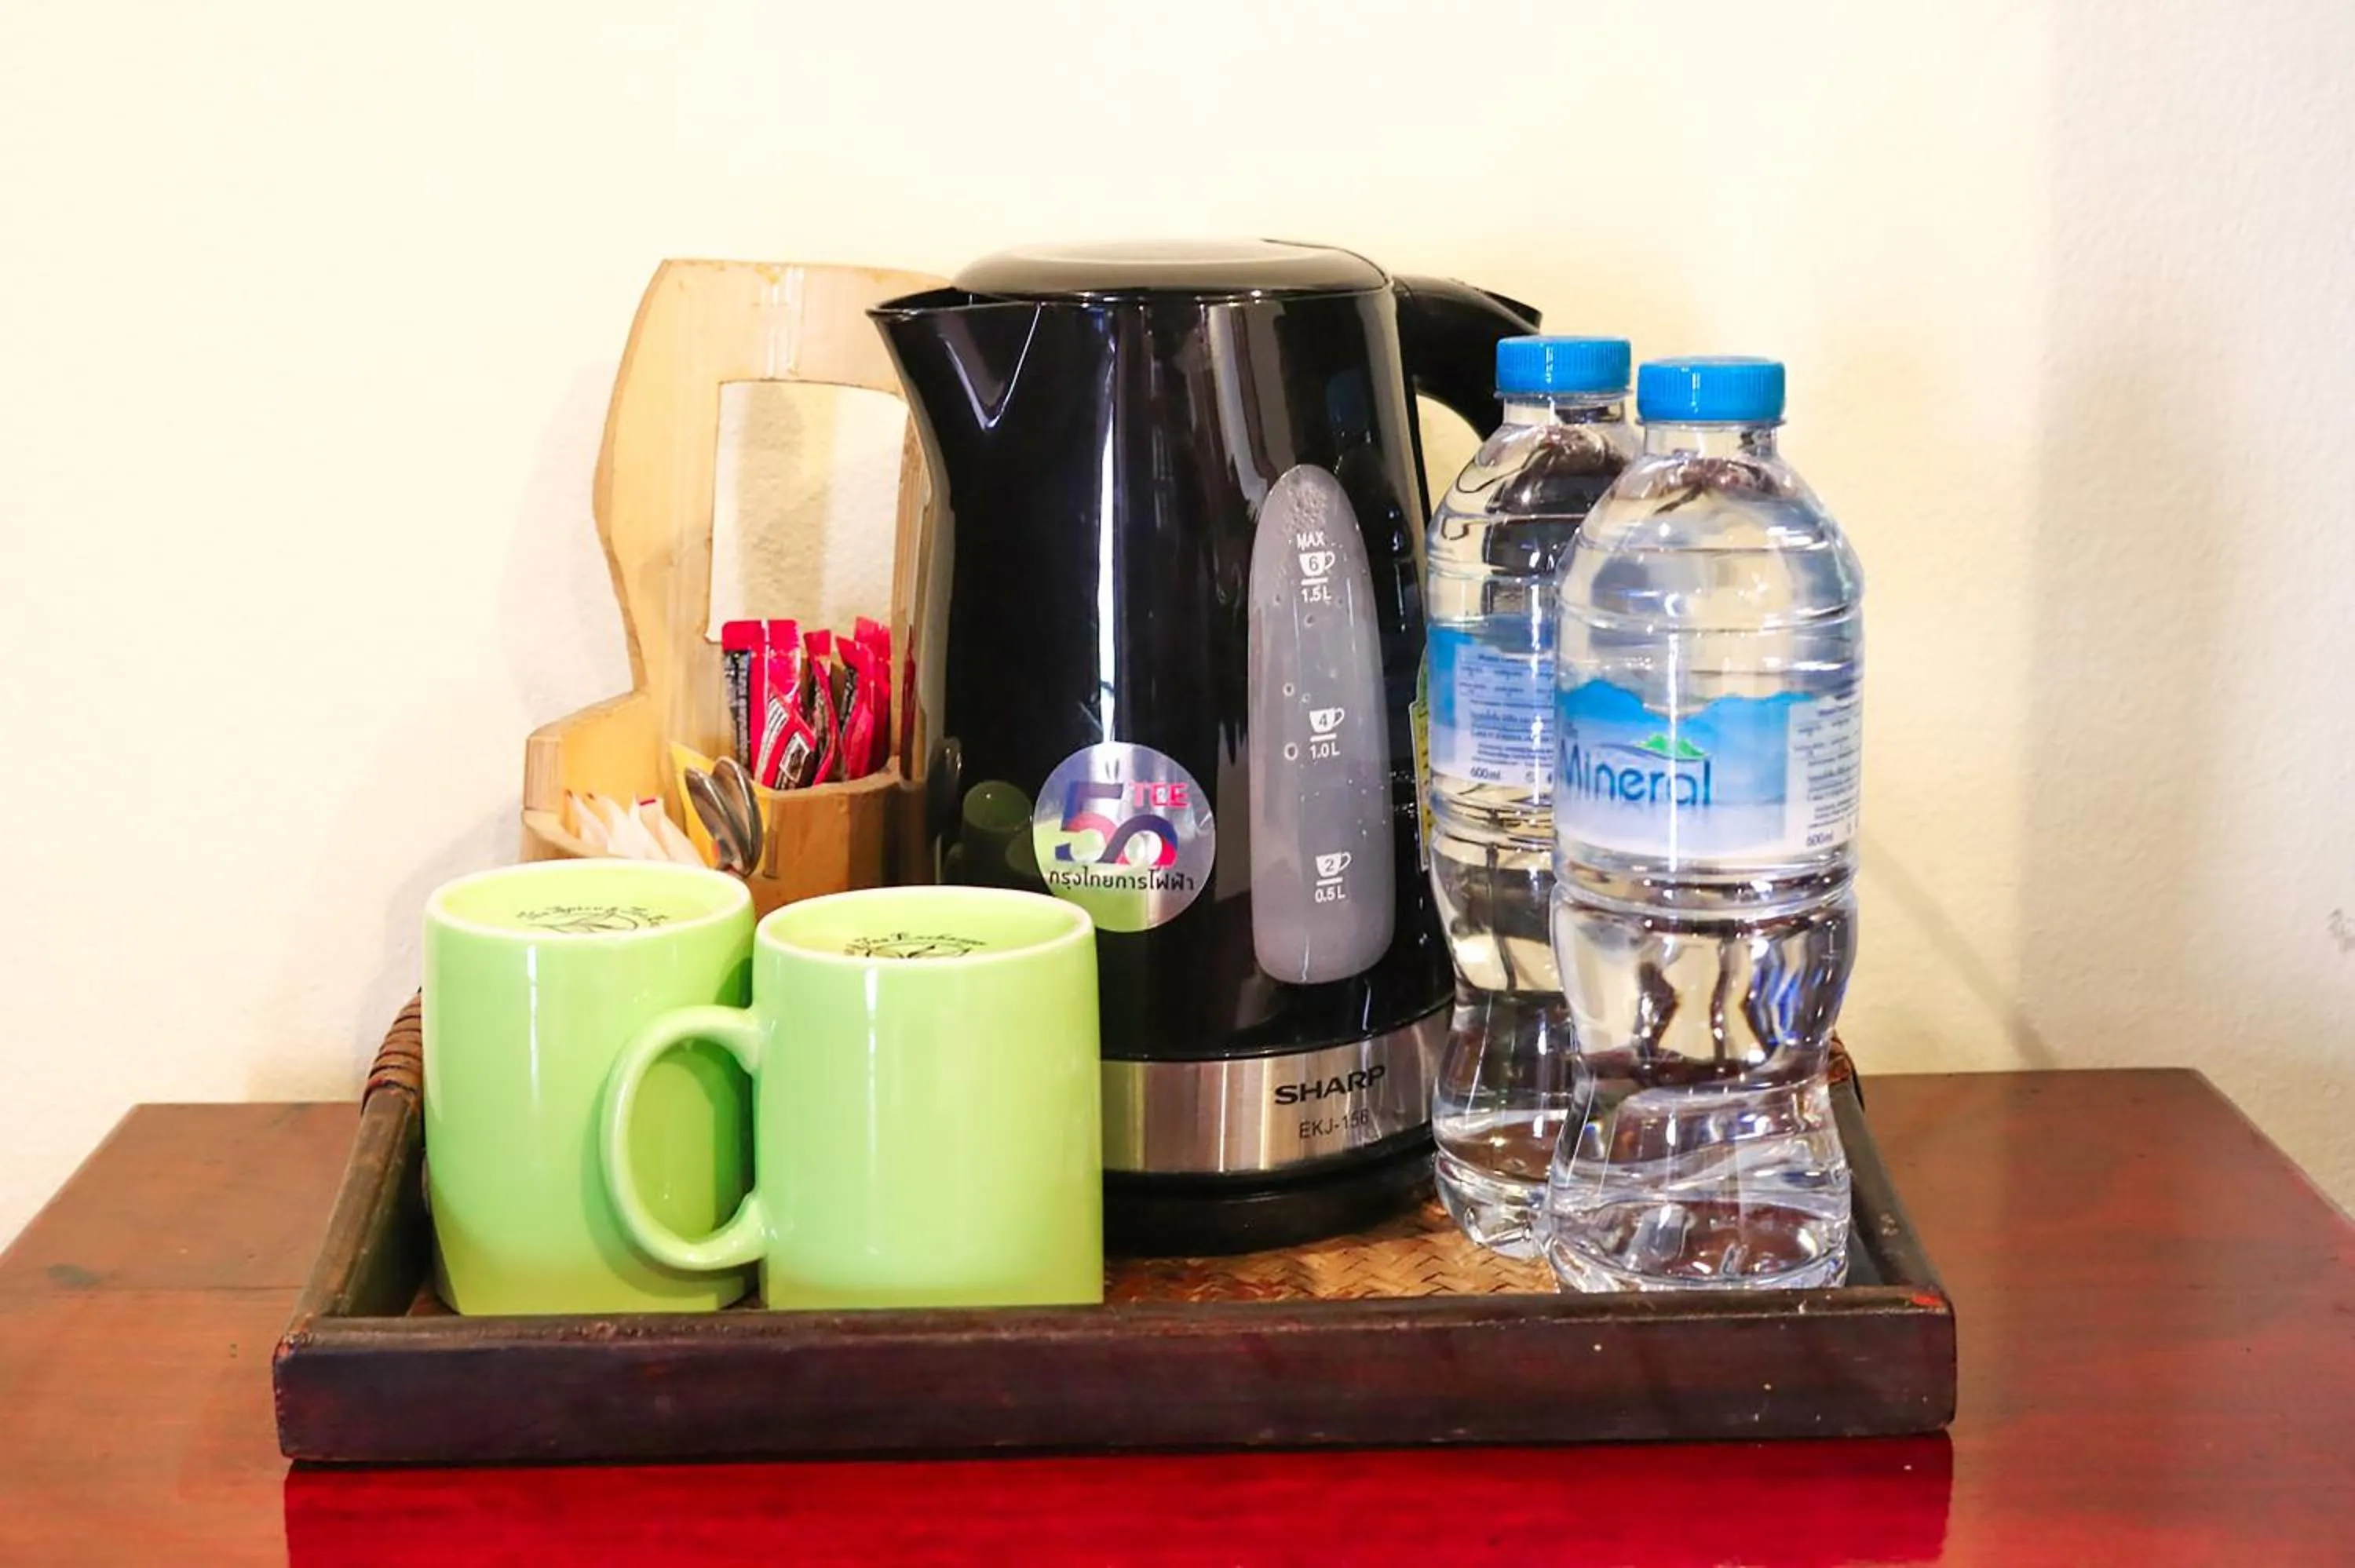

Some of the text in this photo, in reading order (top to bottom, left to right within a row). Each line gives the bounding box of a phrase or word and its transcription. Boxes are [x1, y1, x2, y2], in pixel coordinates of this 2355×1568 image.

[1297, 531, 1325, 551] MAX
[1309, 556, 1320, 571] 6
[1559, 738, 1712, 806] Mineral
[1274, 1065, 1386, 1105] SHARP
